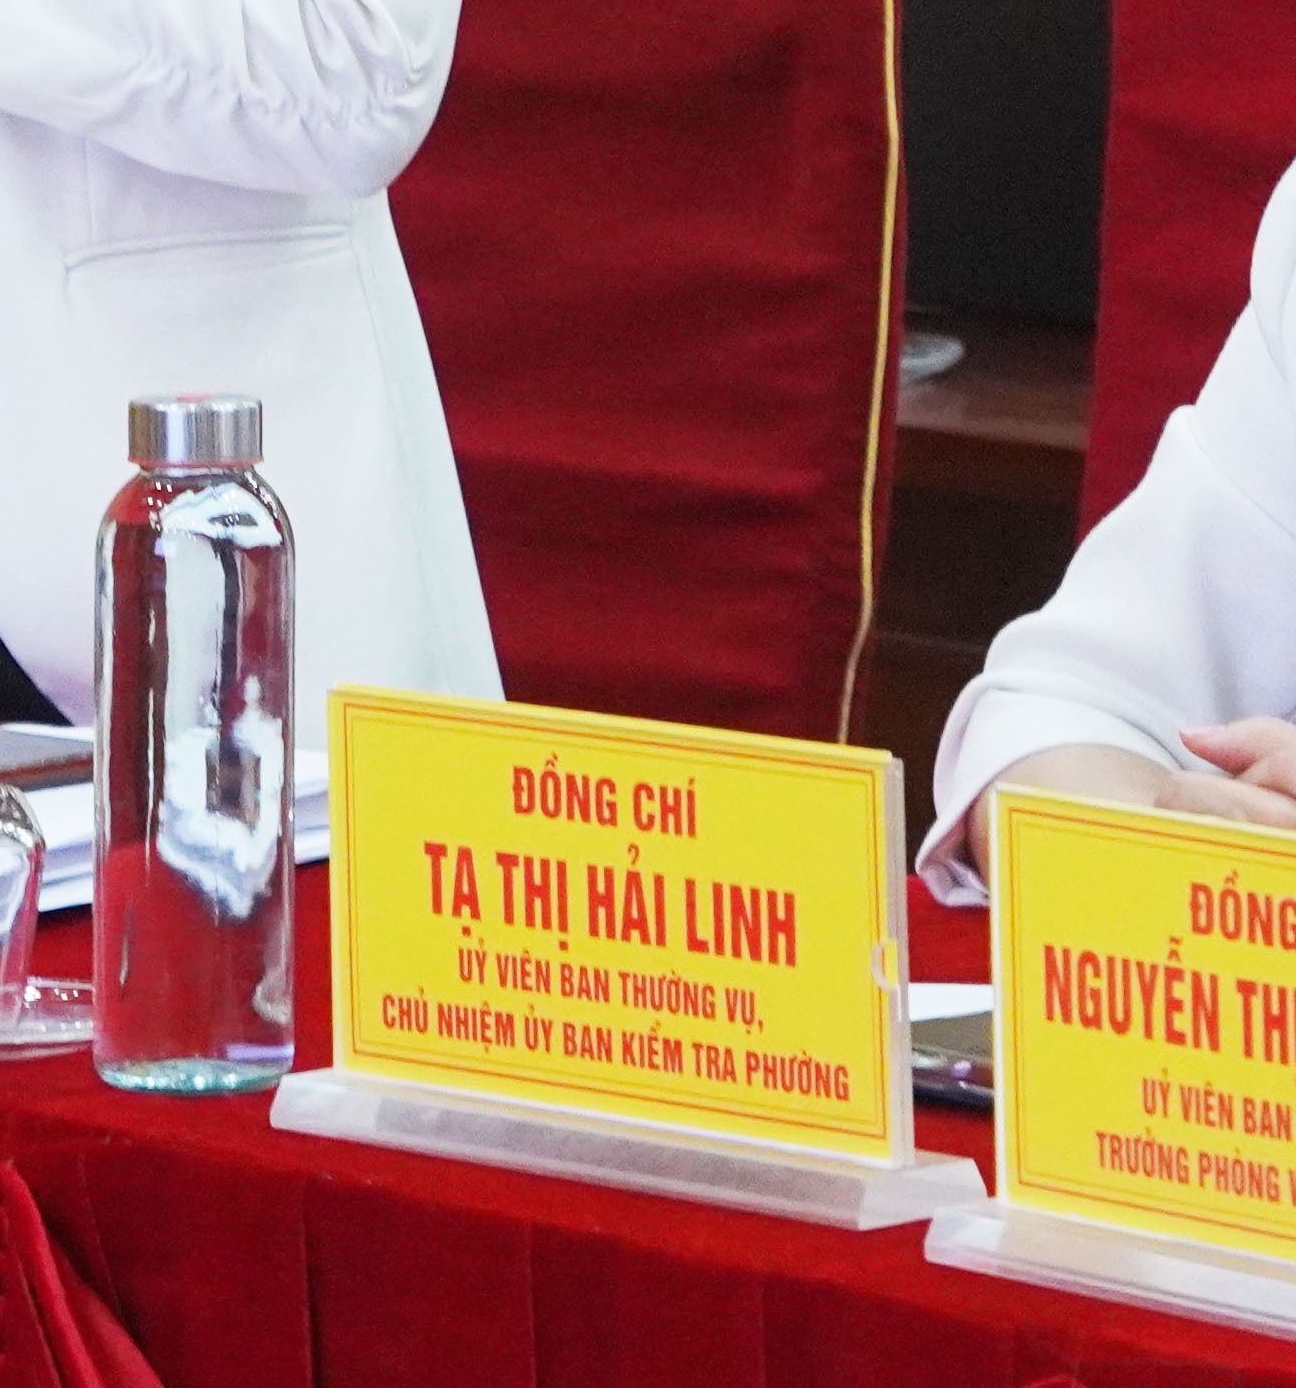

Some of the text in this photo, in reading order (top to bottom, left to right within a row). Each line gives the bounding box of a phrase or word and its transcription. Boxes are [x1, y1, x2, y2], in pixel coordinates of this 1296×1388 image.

[511, 753, 698, 839] ĐỒNG CHÍ
[423, 841, 798, 968] TẠ THỊ HẢI LINH
[458, 937, 765, 1036] UỶ VIÊN BAN THƯỜNG VỤ,
[1043, 936, 1222, 1054] NGUYỄN
[382, 987, 851, 1103] CHỦ NHIỆM ỦY BAN KIỂM TRA PHƯỜNG
[1141, 1066, 1172, 1119] UỶ
[1178, 1079, 1236, 1132] VIÊN
[1242, 1096, 1293, 1143] BAN
[1095, 1126, 1191, 1186] TRƯỞNG
[1197, 1146, 1281, 1204] PHÒNG
